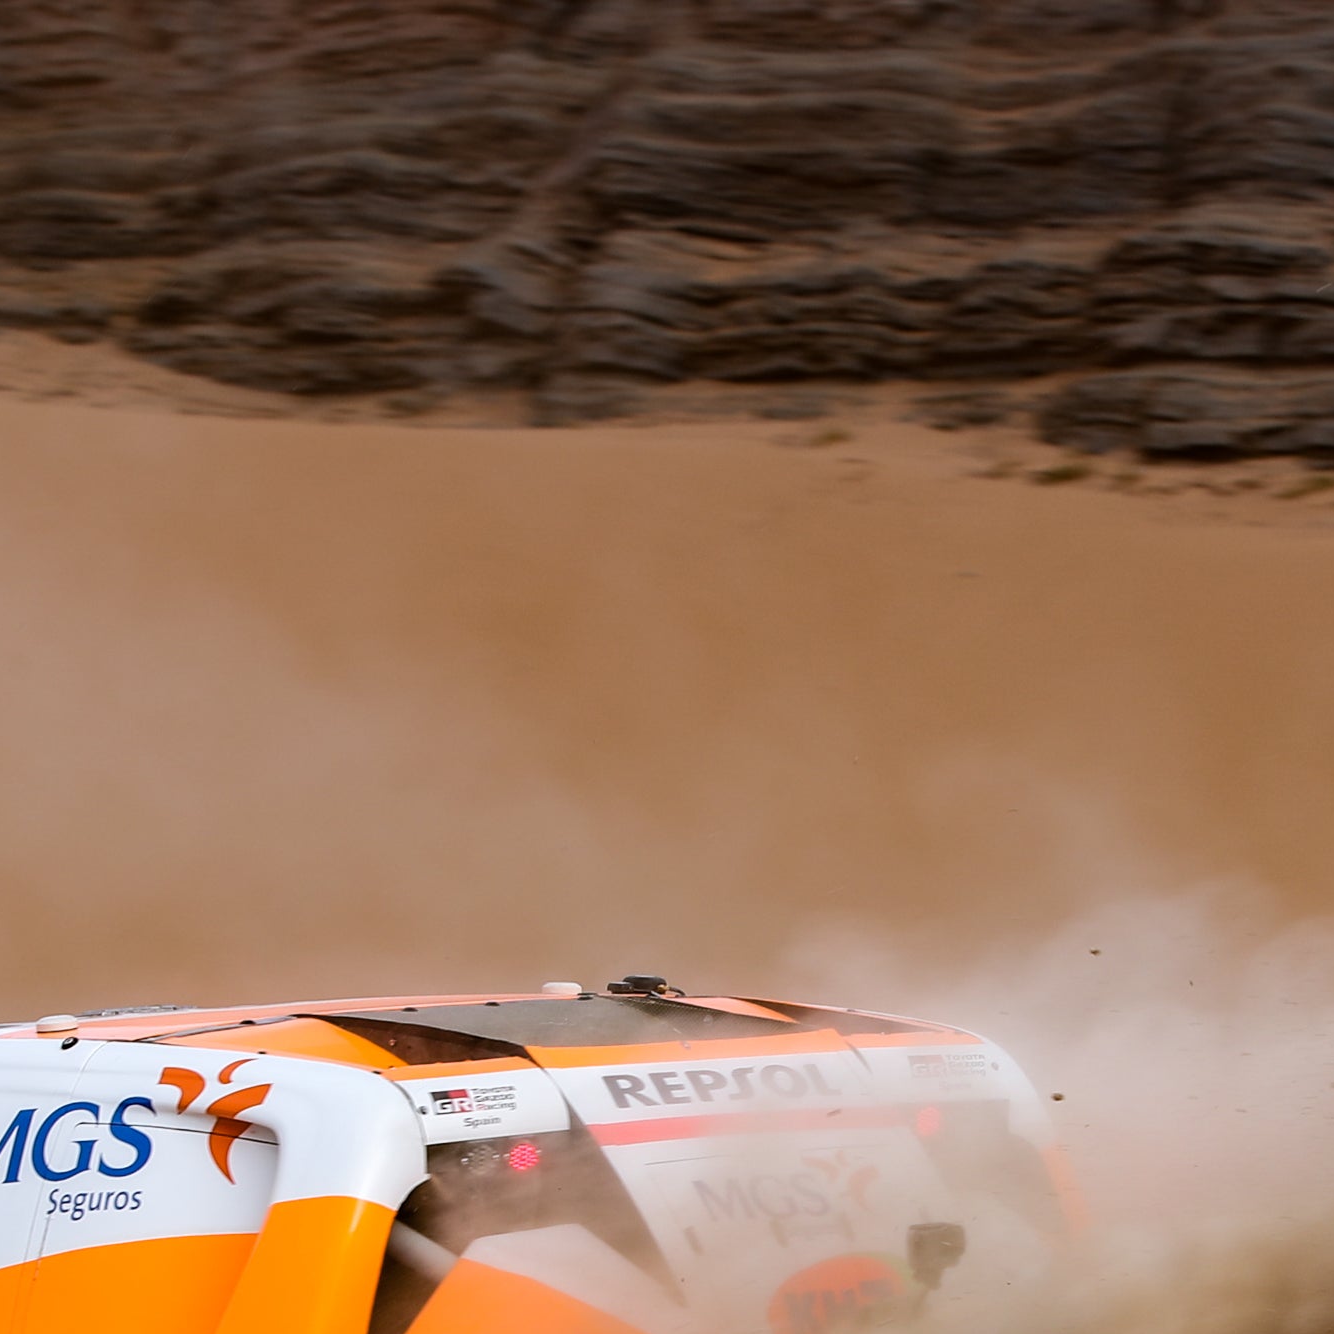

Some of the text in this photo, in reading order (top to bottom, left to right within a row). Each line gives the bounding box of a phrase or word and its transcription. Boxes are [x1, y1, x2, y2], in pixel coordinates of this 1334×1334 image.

[601, 1063, 842, 1109] REPSOL
[433, 1098, 474, 1114] GR
[463, 1116, 502, 1129] Spain
[47, 1187, 142, 1221] Seguros
